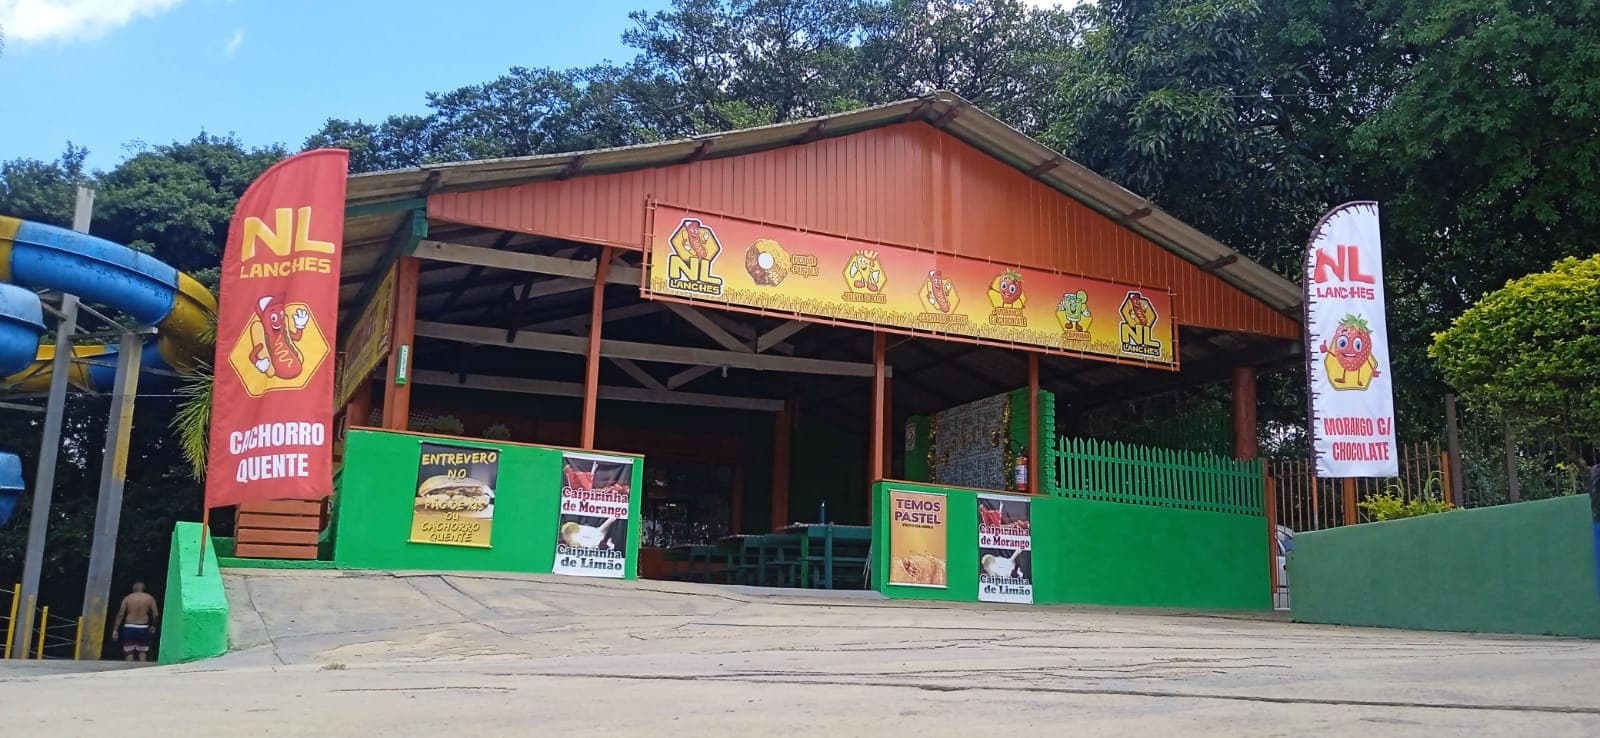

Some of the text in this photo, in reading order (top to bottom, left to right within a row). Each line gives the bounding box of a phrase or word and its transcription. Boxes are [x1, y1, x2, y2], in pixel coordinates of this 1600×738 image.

[241, 206, 335, 261] NL
[240, 257, 331, 279] LANCHES
[669, 254, 722, 285] NL
[1314, 244, 1376, 284] NL
[670, 280, 720, 294] LANCHES
[1316, 286, 1375, 300] LANCHES
[1123, 323, 1160, 347] NL
[1123, 344, 1160, 356] LANCHES
[1324, 416, 1392, 436] MORANGO C/
[229, 421, 325, 455] CACHORRO
[1332, 441, 1389, 461] CHOCOLATE
[421, 451, 497, 466] ENTREVERO
[236, 452, 309, 484] QUENTE
[447, 469, 467, 479] NO
[562, 487, 629, 504] Caipirinha
[563, 500, 628, 517] de Morango
[895, 498, 941, 512] TEMOS
[446, 512, 460, 521] OU
[894, 511, 942, 525] PASTEL
[422, 521, 481, 532] CACHORRO
[979, 524, 1029, 537] Caipirinha
[431, 532, 473, 542] QUENTE
[981, 535, 1030, 549] de Morango
[557, 544, 622, 559] Caipirinha
[560, 557, 623, 571] de Limão
[980, 574, 1030, 586] Caipirinha
[984, 585, 1031, 596] de Limão
